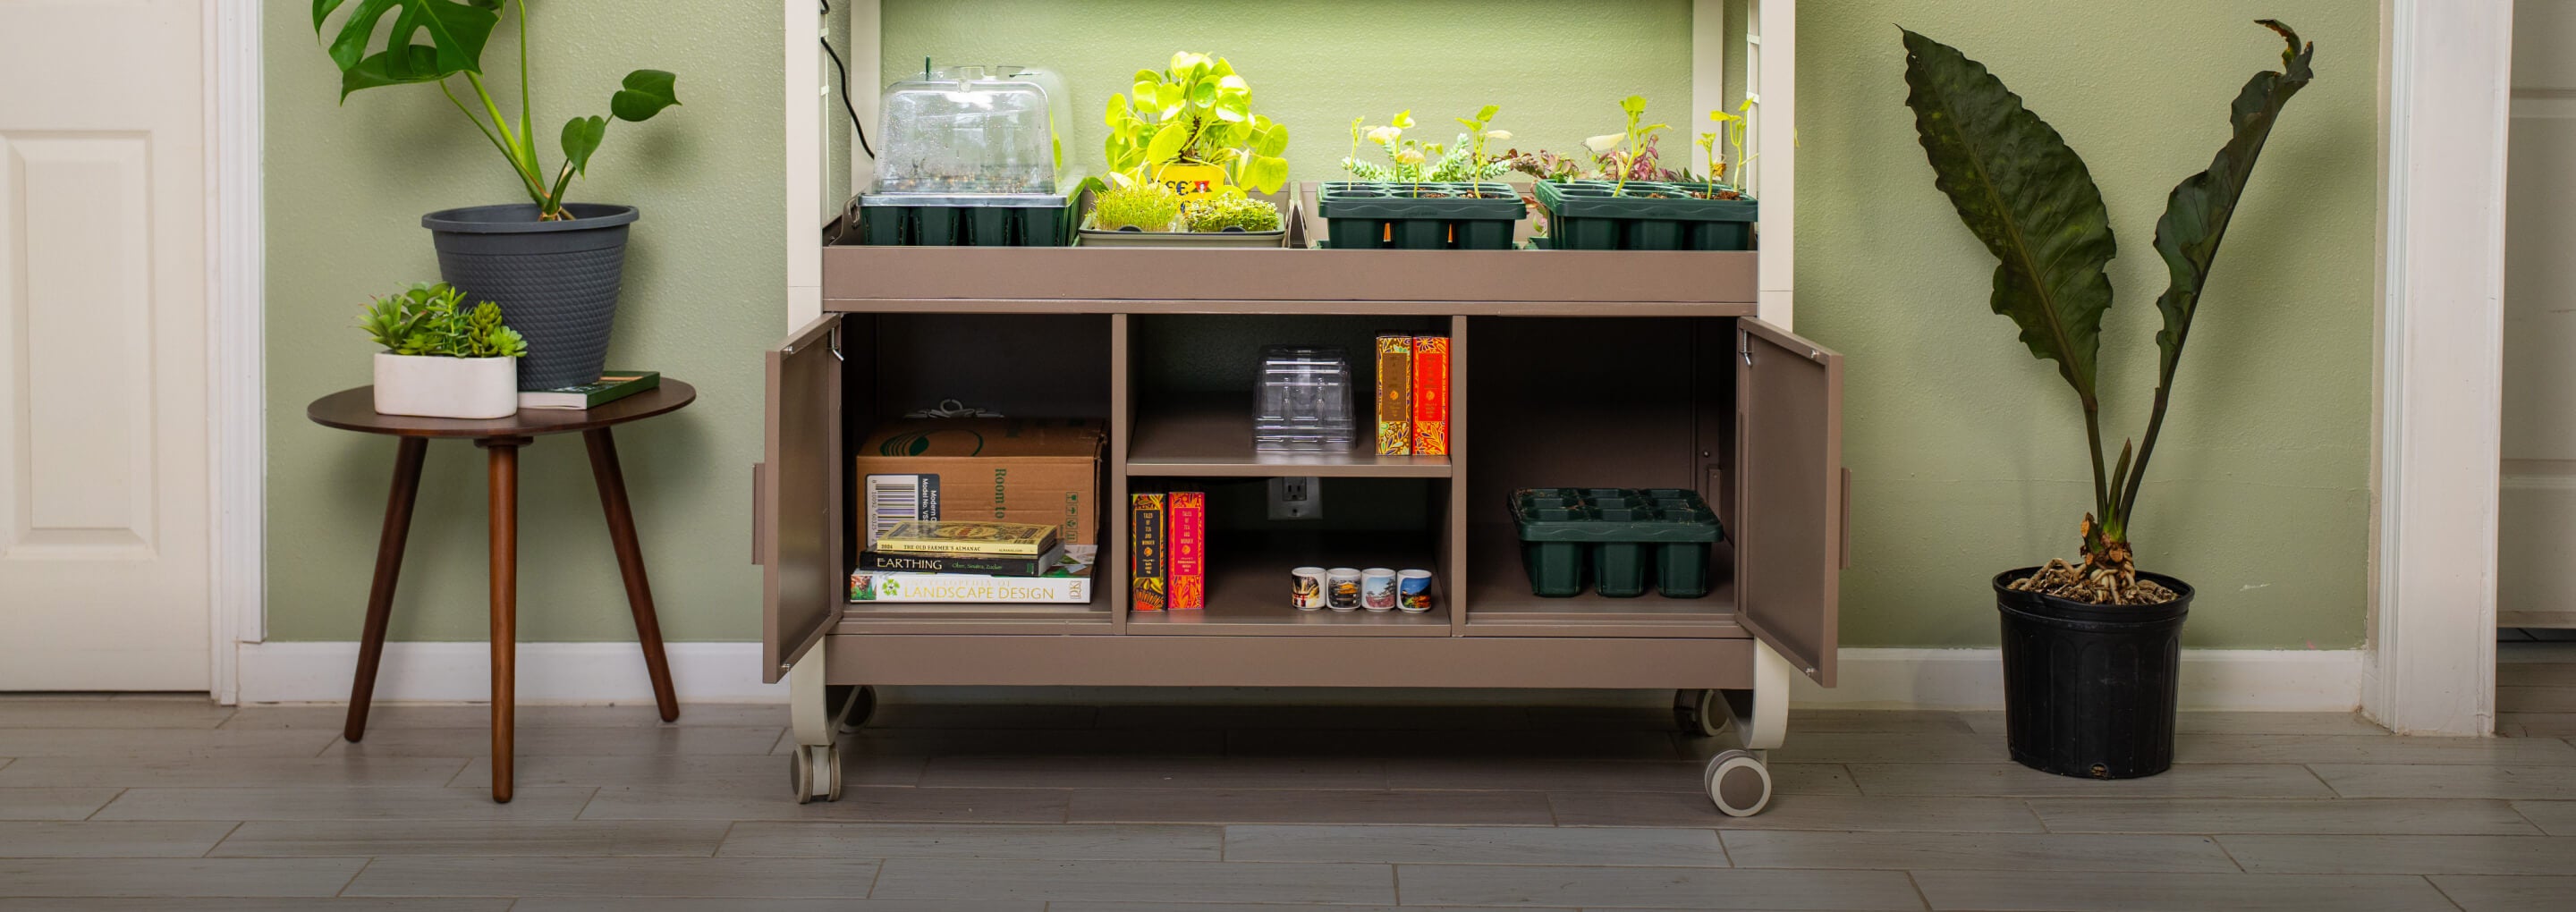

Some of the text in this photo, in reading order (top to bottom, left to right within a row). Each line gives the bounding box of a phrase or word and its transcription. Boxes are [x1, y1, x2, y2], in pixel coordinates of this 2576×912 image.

[995, 469, 1006, 519] Room to
[877, 558, 943, 570] EARTHING
[904, 586, 1055, 600] LANDSCAPE DESIGN
